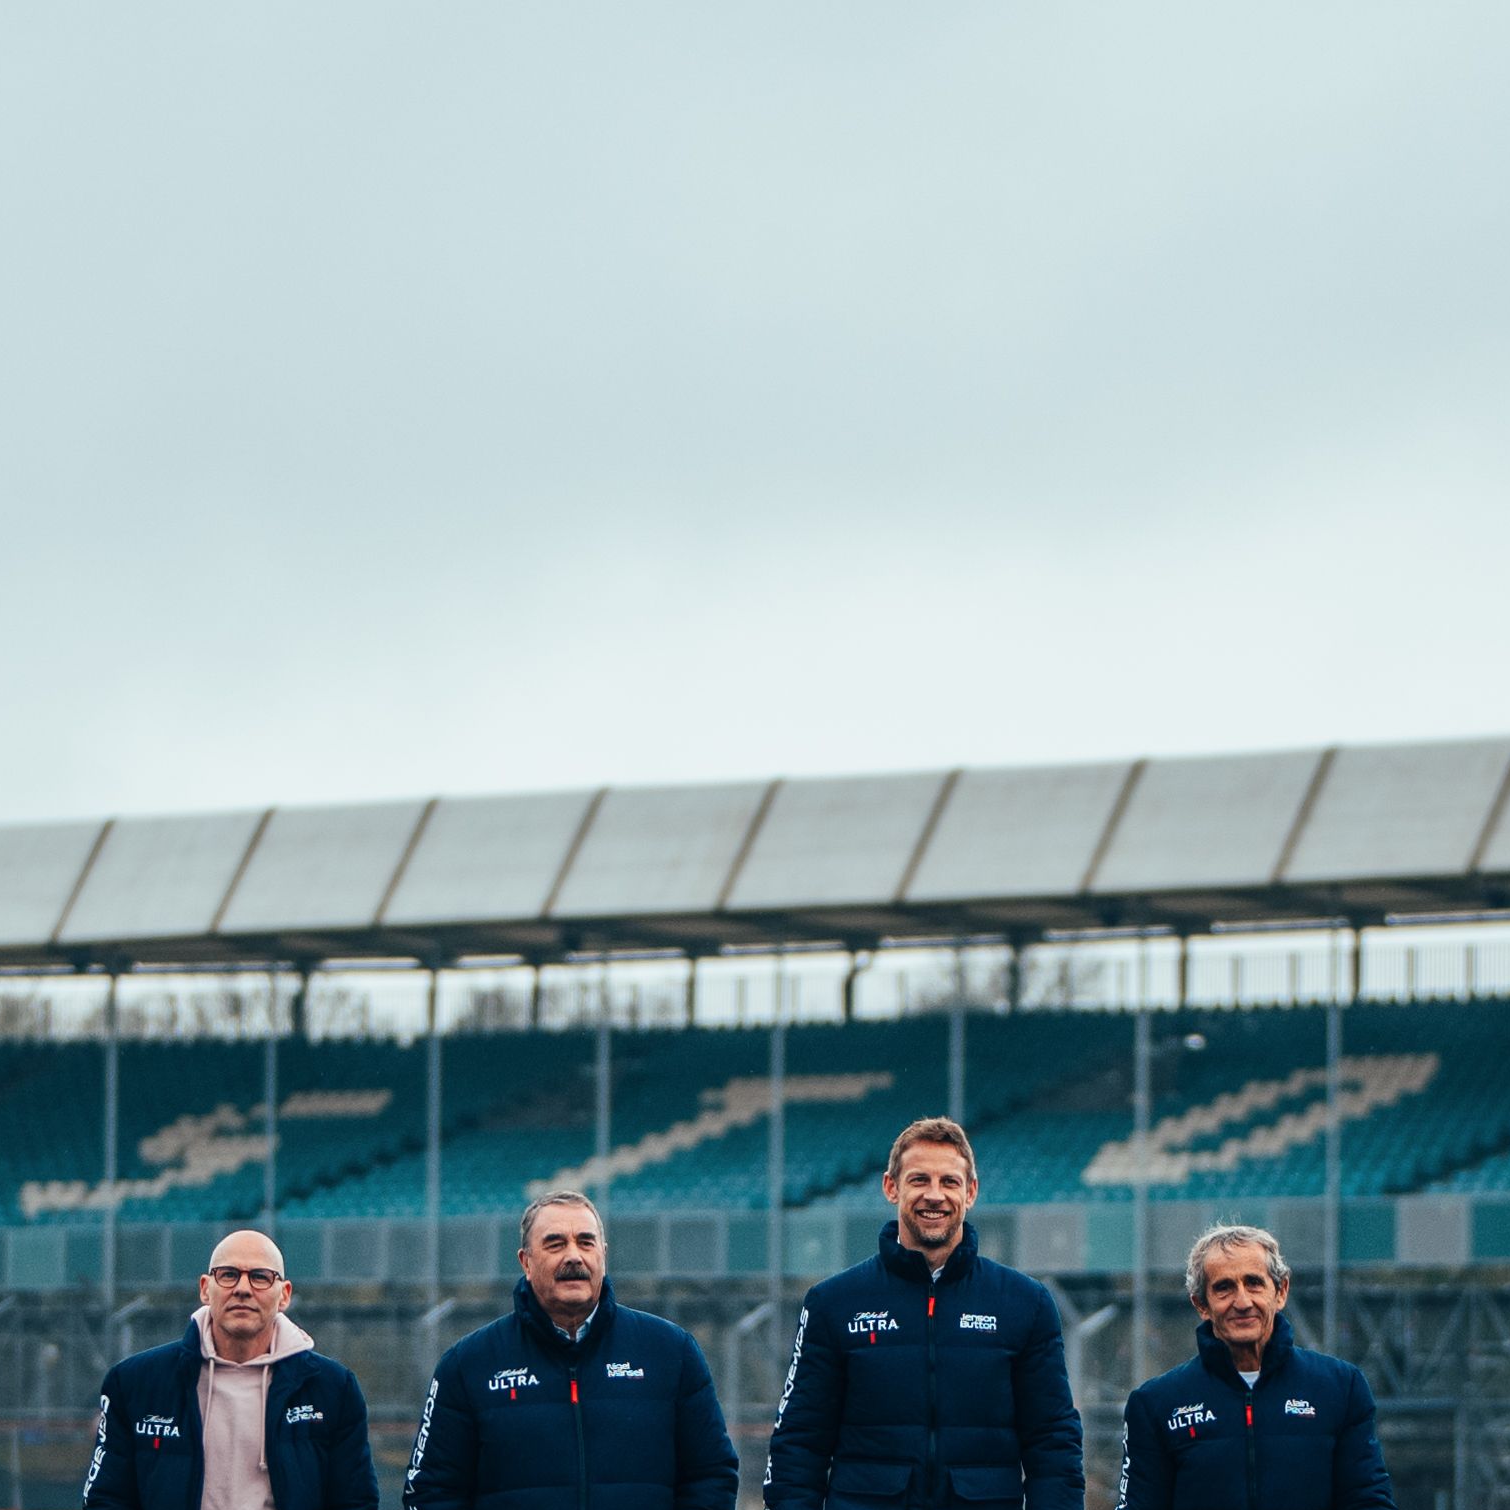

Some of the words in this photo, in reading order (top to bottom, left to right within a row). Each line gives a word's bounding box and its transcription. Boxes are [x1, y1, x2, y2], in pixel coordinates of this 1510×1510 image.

[960, 1313, 997, 1323] Jenson
[960, 1319, 997, 1330] Button
[848, 1319, 900, 1333] ULTRA
[488, 1374, 540, 1391] ULTRA
[1168, 1410, 1217, 1431] ULTRA
[136, 1422, 181, 1437] ULTRA
